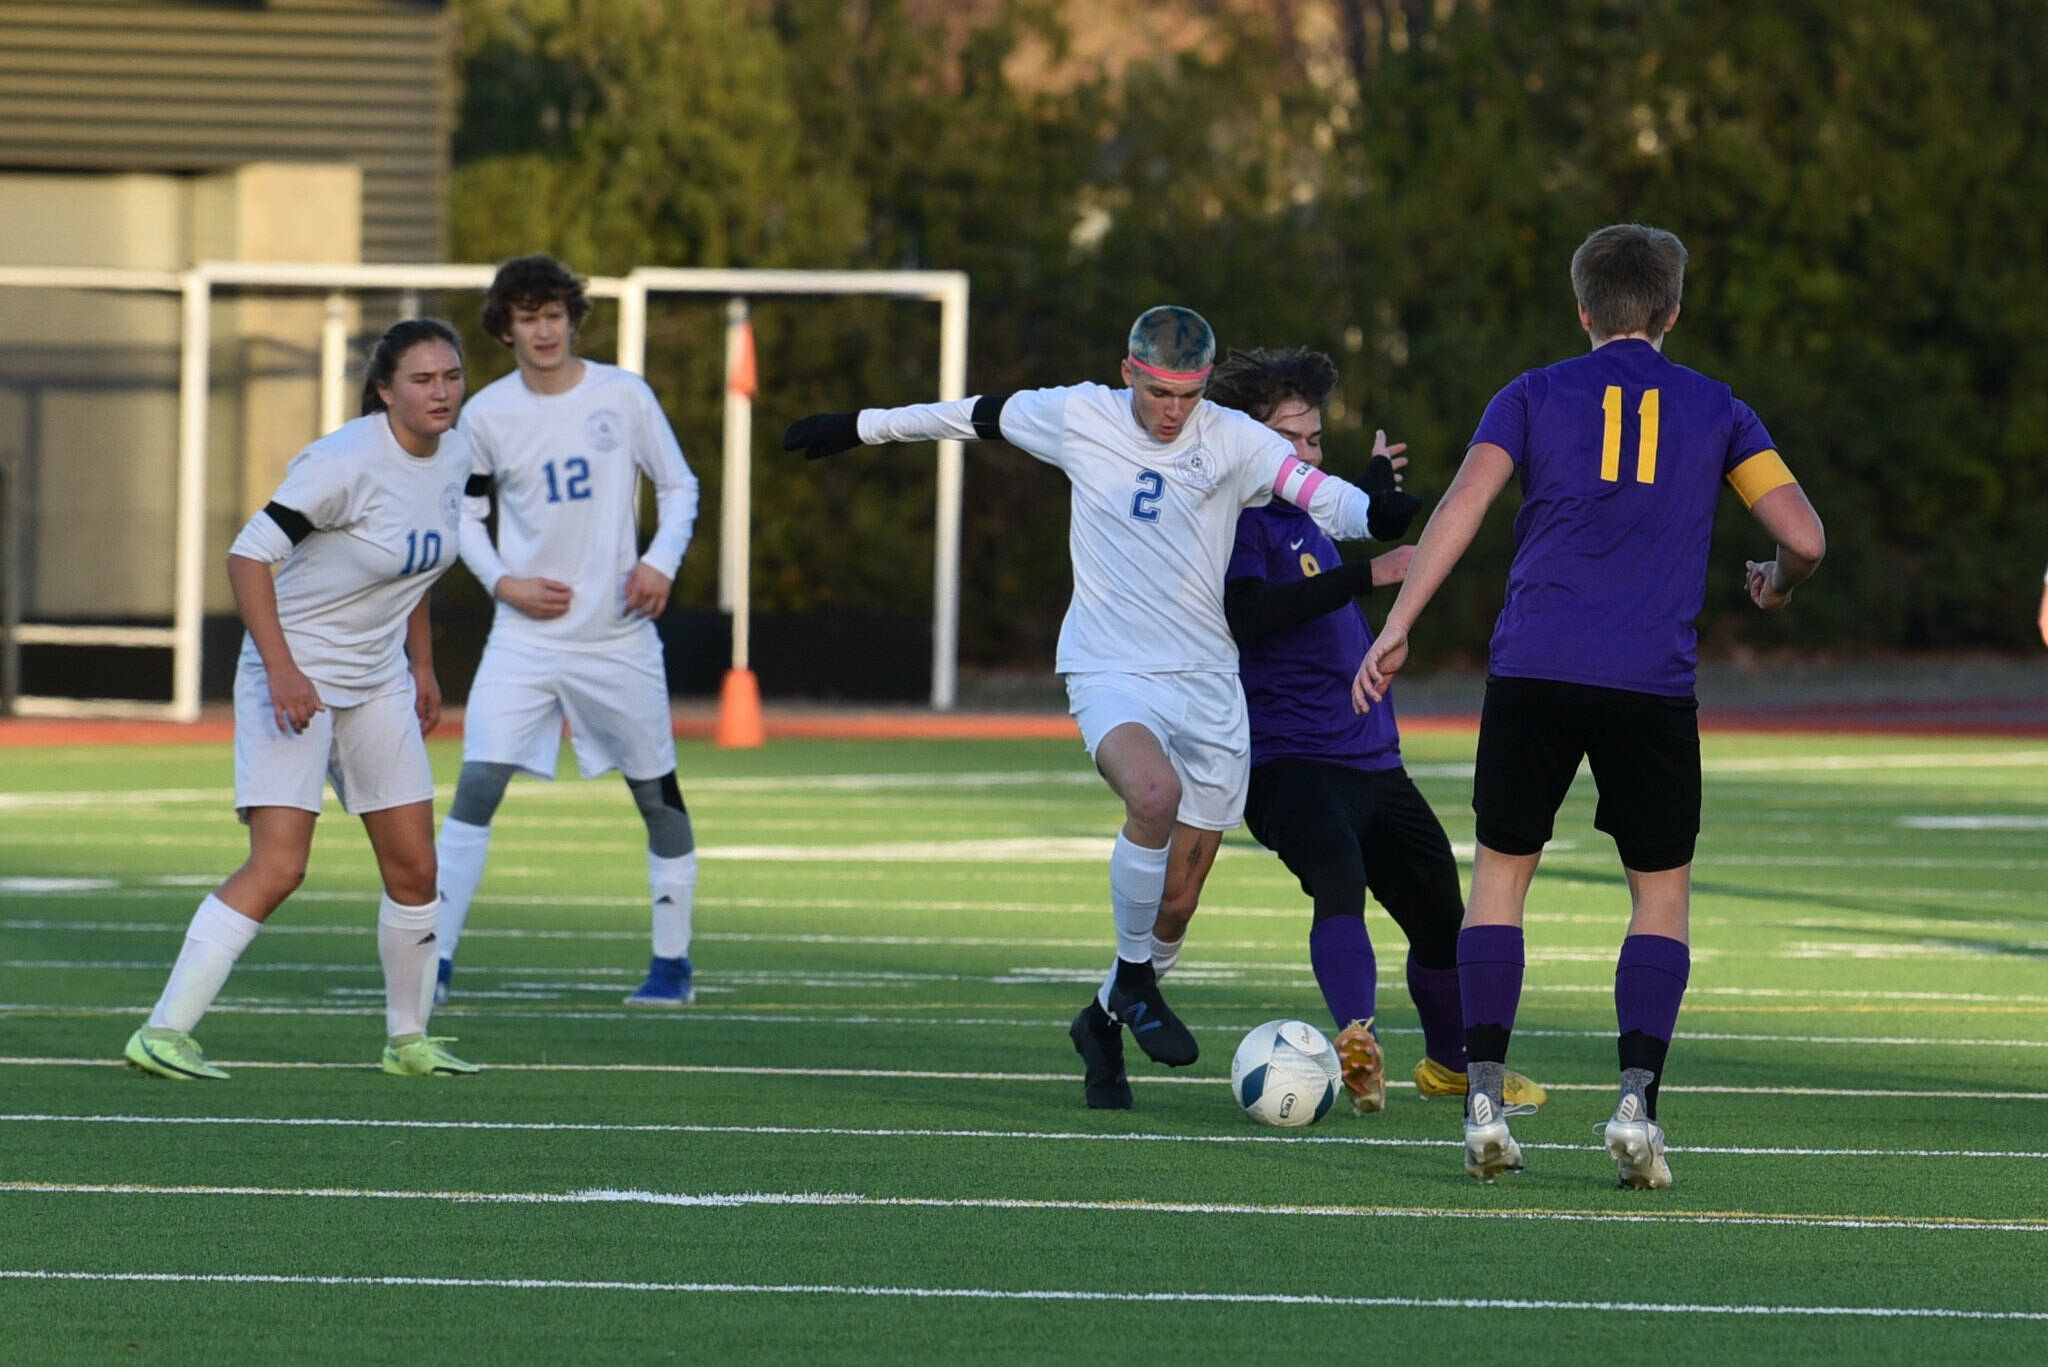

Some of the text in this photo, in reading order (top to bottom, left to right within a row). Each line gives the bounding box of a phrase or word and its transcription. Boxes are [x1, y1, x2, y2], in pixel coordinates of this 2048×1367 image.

[1600, 385, 1660, 484] 11
[543, 456, 592, 503] 12
[1130, 468, 1166, 524] 2
[400, 530, 442, 574] 10
